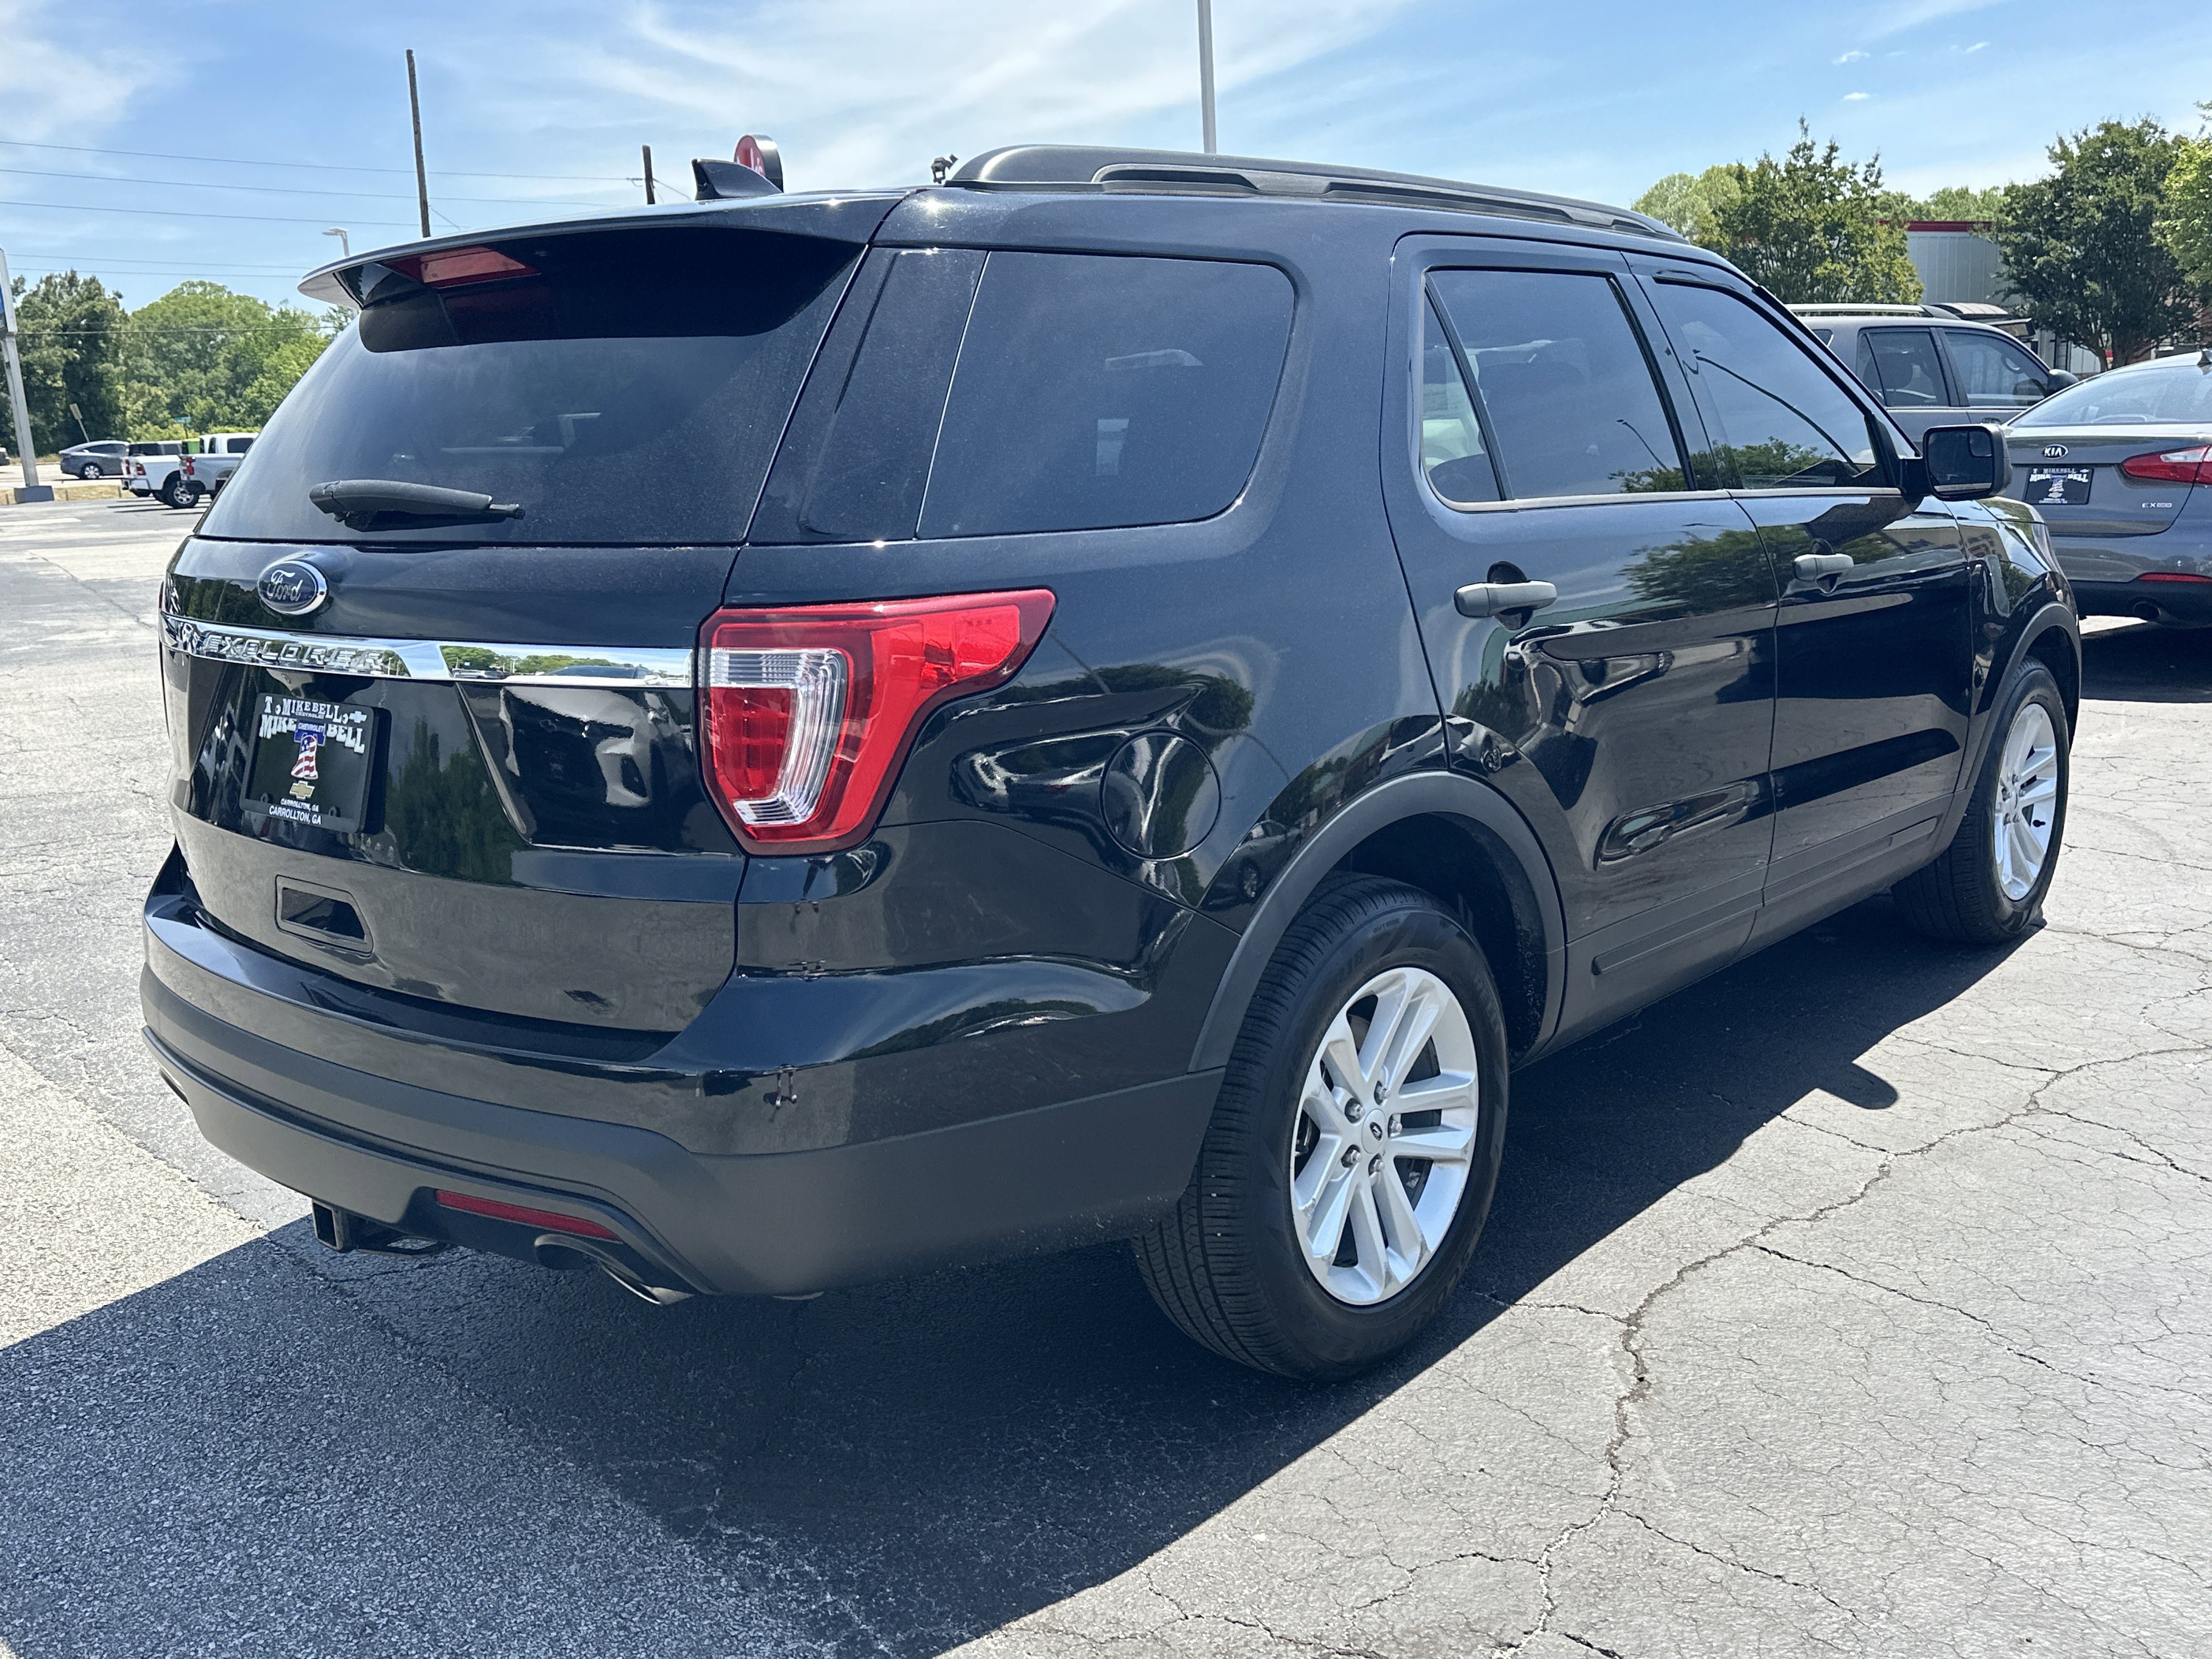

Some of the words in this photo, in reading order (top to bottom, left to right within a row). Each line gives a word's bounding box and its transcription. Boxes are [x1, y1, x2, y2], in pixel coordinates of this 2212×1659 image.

[2044, 447, 2062, 456] KIA
[266, 569, 303, 602] Ford
[204, 634, 385, 670] EXPLORER
[258, 714, 297, 739] MIKE
[326, 723, 365, 754] BELL
[298, 722, 325, 733] CHEVROLET
[269, 805, 311, 825] CARROLLTON,
[312, 814, 321, 825] GA
